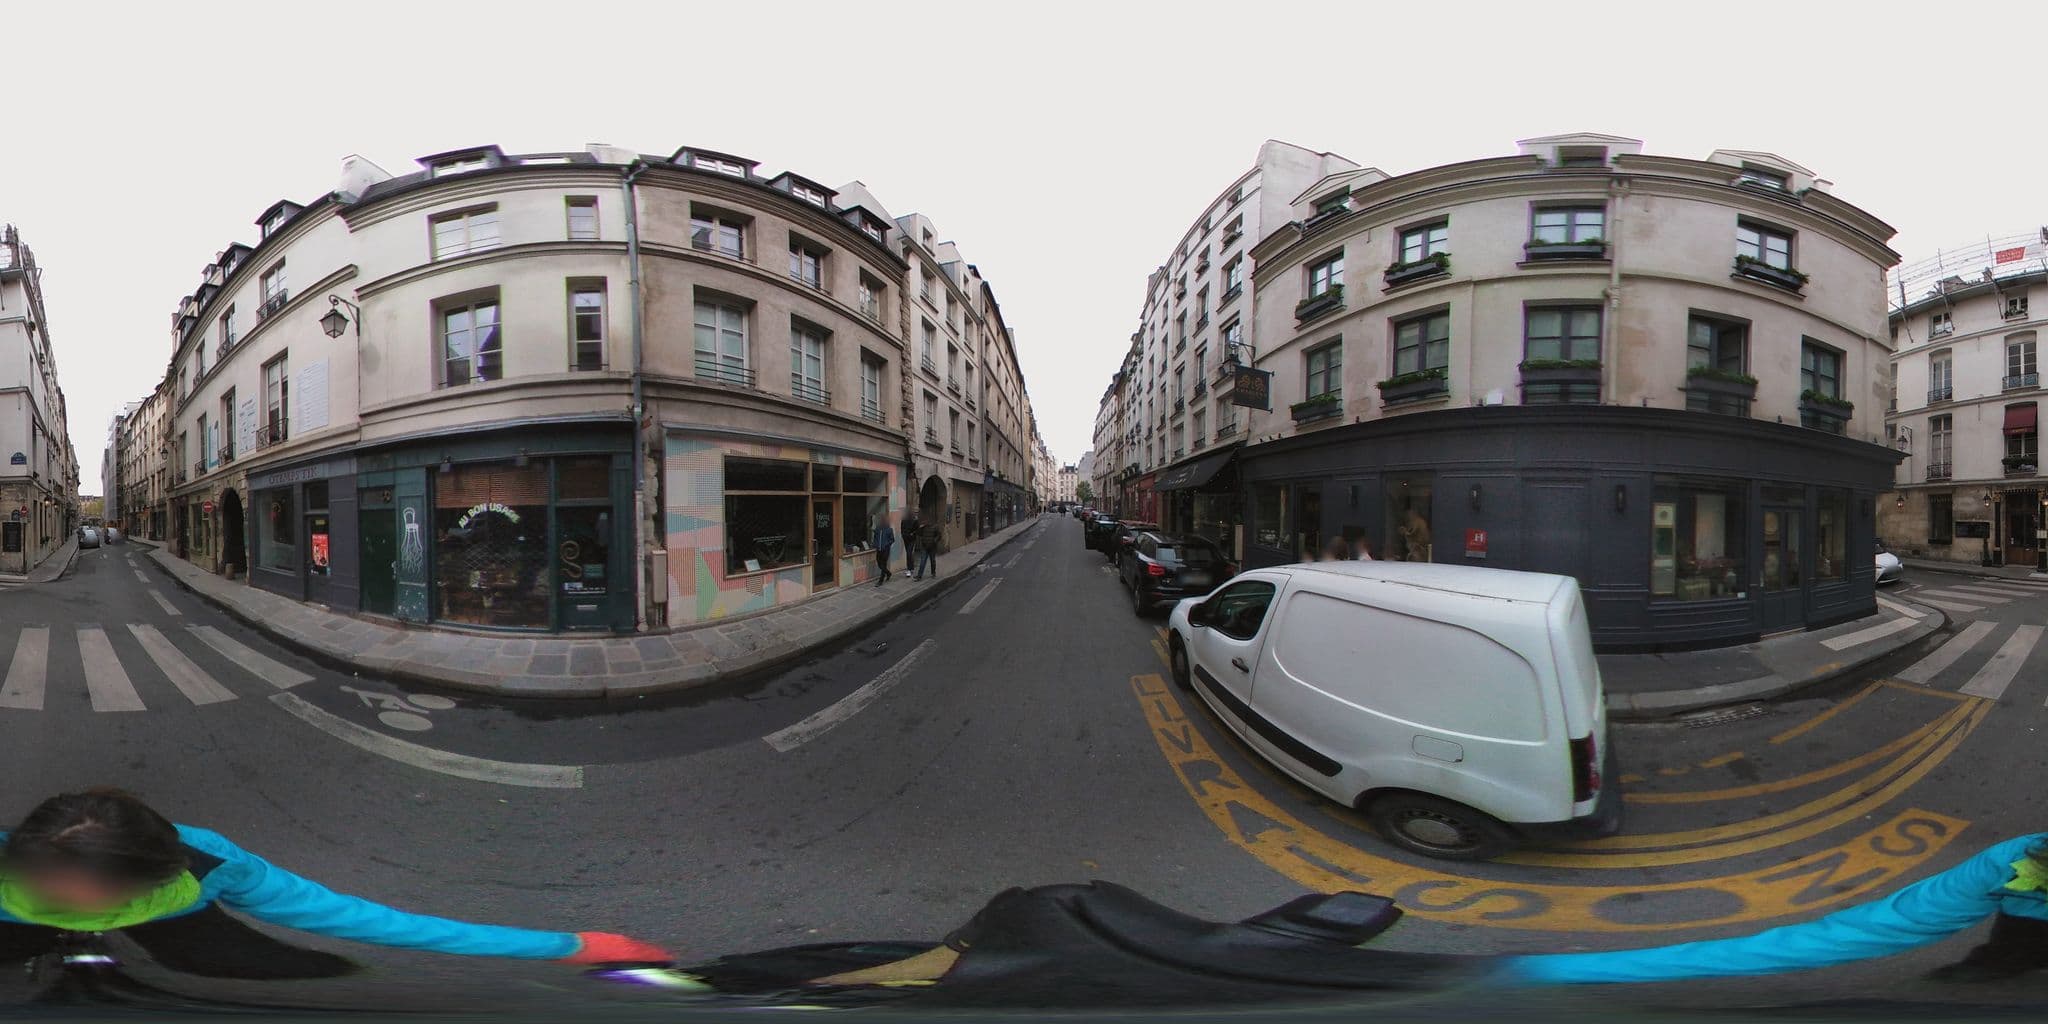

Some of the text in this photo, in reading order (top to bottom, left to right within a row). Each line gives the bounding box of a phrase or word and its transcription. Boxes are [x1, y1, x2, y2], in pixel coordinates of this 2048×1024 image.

[458, 502, 521, 529] AU BON USAGE
[1134, 675, 1947, 926] LIVRAISONS
